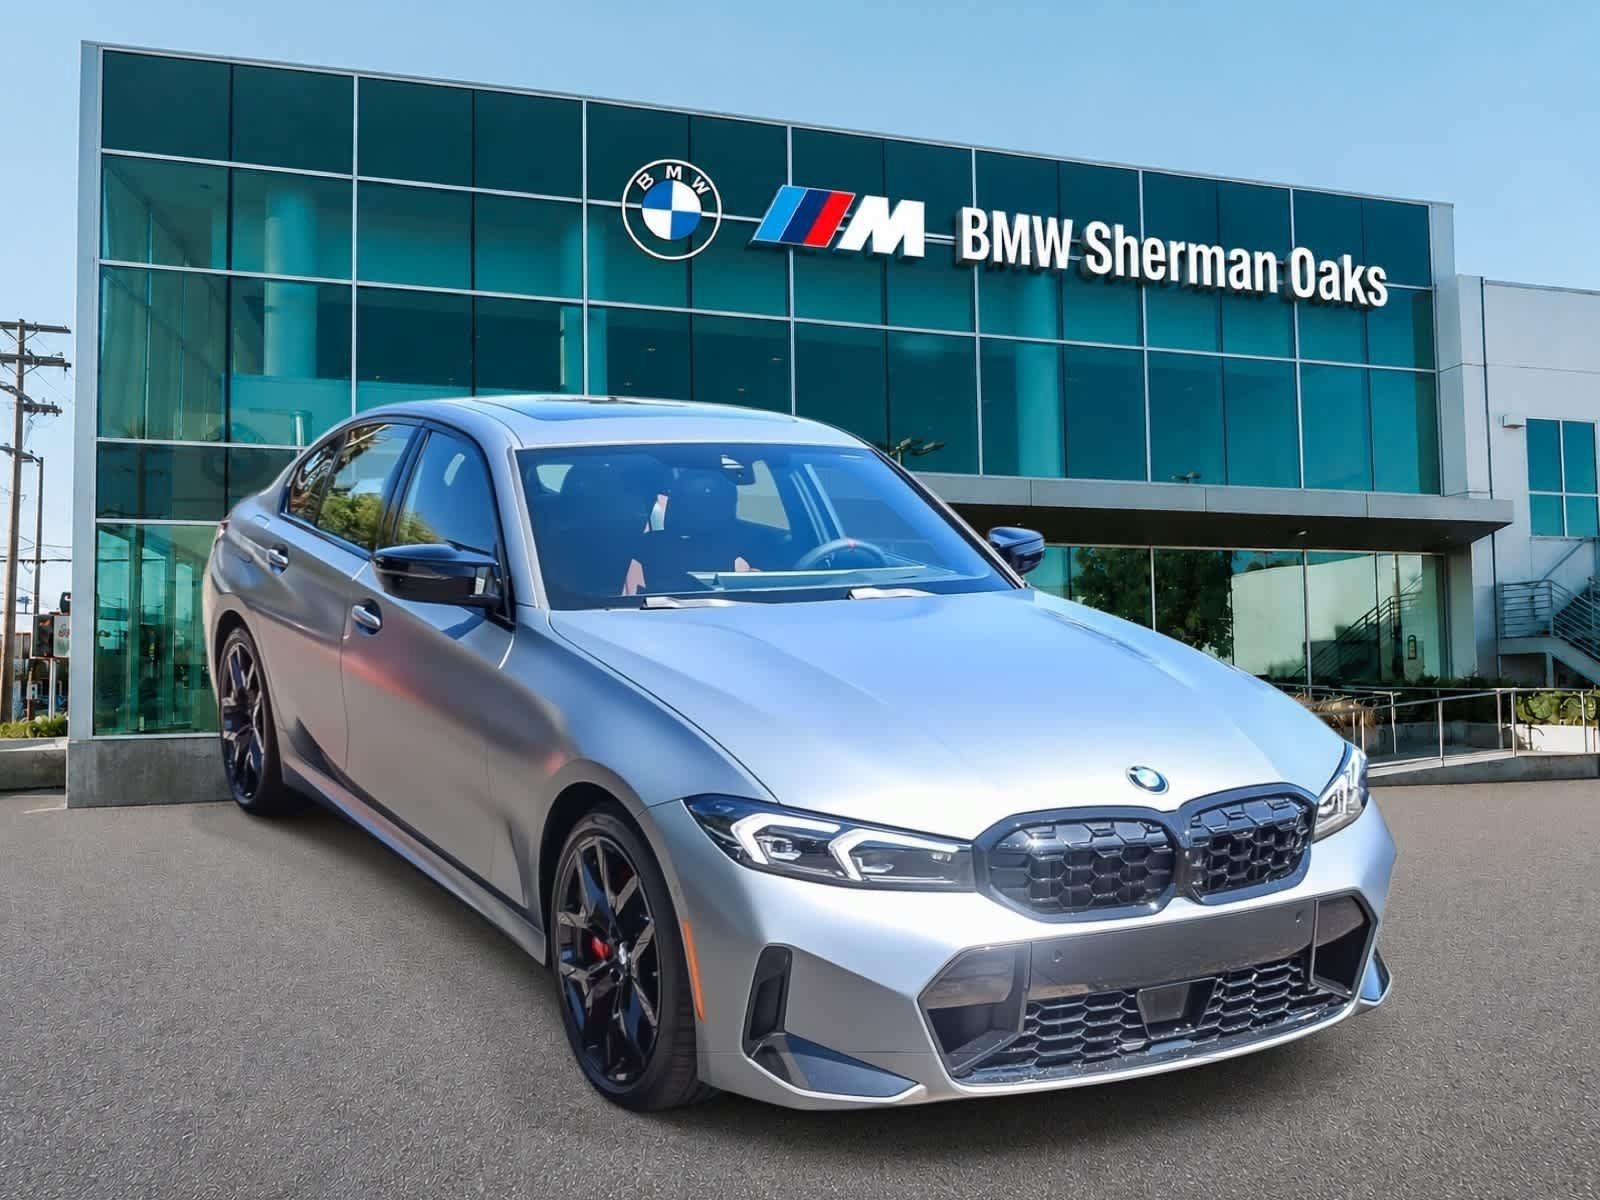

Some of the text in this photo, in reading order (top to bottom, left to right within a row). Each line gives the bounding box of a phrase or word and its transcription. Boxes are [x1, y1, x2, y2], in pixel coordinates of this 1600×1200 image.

[637, 165, 711, 196] BMW
[959, 206, 1389, 308] BMW Sherman Oaks
